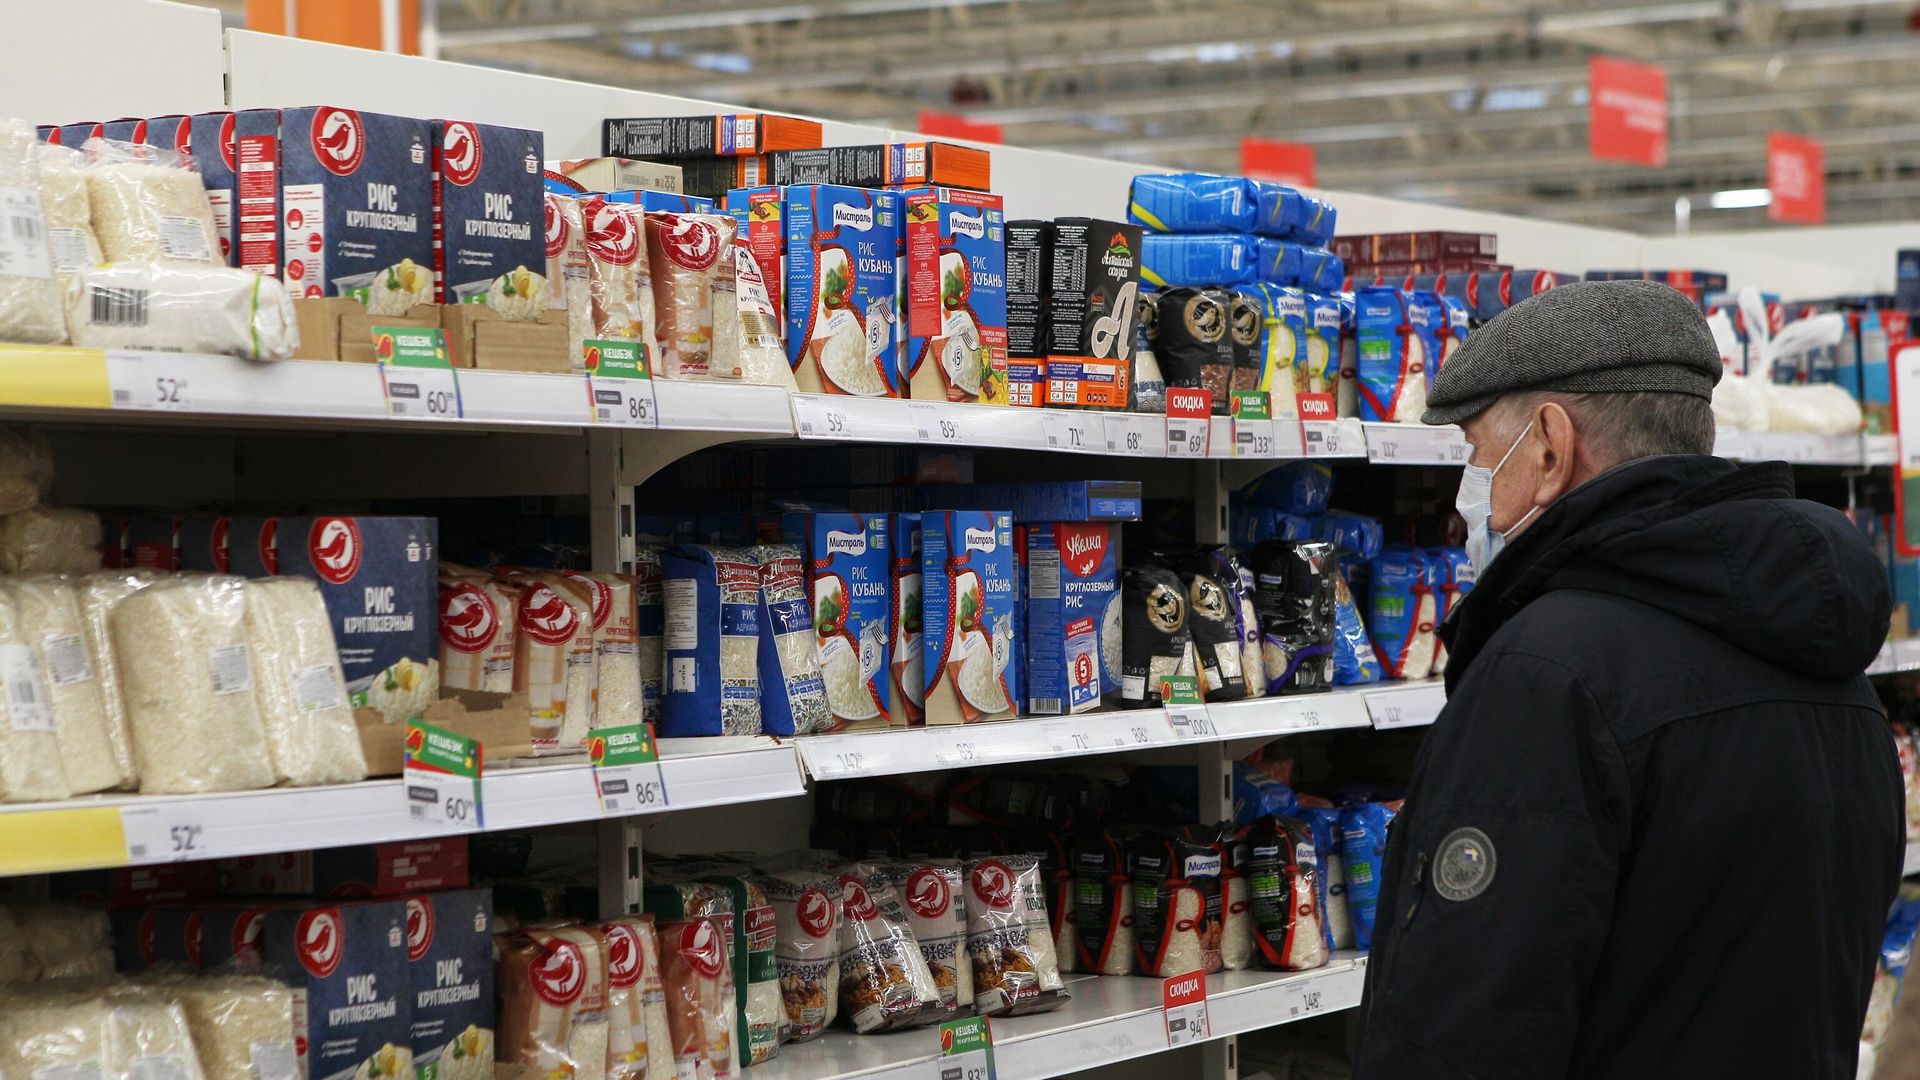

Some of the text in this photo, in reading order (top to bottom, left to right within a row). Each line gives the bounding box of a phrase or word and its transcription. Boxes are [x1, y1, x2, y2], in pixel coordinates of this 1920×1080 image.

[367, 183, 397, 212] РИС
[484, 193, 512, 220] РИС
[346, 210, 417, 233] КРУГЛОЗЕРНЫЙ
[836, 210, 871, 225] Мистраль
[952, 218, 982, 232] Мистраль
[465, 220, 531, 240] КРУГЛОЗЕРНЫЙ
[858, 241, 875, 255] РИС
[858, 258, 893, 274] КУБАНЬ
[973, 256, 986, 269] РИС
[973, 272, 1002, 287] КУБАНЬ
[603, 347, 633, 359] КЕШБЭК
[157, 378, 178, 402] 52
[427, 391, 447, 413] 60
[629, 398, 646, 418] 86
[1173, 395, 1204, 412] СКИДКА
[1243, 397, 1261, 405] КЕШБЭК
[1302, 399, 1329, 415] СКИДКА
[827, 413, 842, 431] 59
[940, 420, 955, 438] 89
[1069, 428, 1080, 445] 71
[1127, 432, 1138, 449] 68
[1190, 435, 1200, 452] 69
[1253, 437, 1268, 453] 133
[1327, 436, 1337, 451] 69
[1382, 441, 1396, 458] 112
[829, 537, 864, 550] Мистраль
[967, 534, 994, 547] Мистраль
[1066, 534, 1101, 560] Увелка
[852, 566, 868, 580] РИС
[985, 563, 998, 576] РИС
[852, 583, 885, 597] КУБАНЬ
[986, 579, 1011, 593] КУБАНЬ
[1065, 580, 1114, 592] КРУГЛОЗЕРНЫЙ
[365, 587, 394, 614] РИС
[1065, 596, 1083, 607] РИС
[344, 613, 414, 634] КРУГЛОЗЕРНЫЙ
[1080, 661, 1087, 678] 5
[1173, 682, 1191, 690] КЕШБЭК
[1385, 707, 1400, 722] 112
[1132, 727, 1148, 742] 88
[1189, 720, 1208, 734] 100
[428, 732, 463, 753] КЕШБЭК
[607, 732, 638, 746] КЕШБЭК
[1072, 734, 1088, 748] 71
[956, 743, 973, 759] 89
[636, 781, 655, 804] 86
[446, 797, 466, 820] 60
[170, 826, 196, 851] 52
[436, 958, 463, 987] РИС
[347, 974, 377, 1004] РИС
[418, 979, 480, 1008] КРУГЛОЗЕРНЫЙ
[1169, 978, 1199, 997] СКИДКА
[1303, 992, 1319, 1010] 148
[329, 997, 396, 1026] КРУГЛОЗЕРНЫЙ
[956, 1024, 979, 1037] КЕШБЭК
[1190, 1019, 1202, 1036] 94
[968, 1069, 980, 1080] 83
